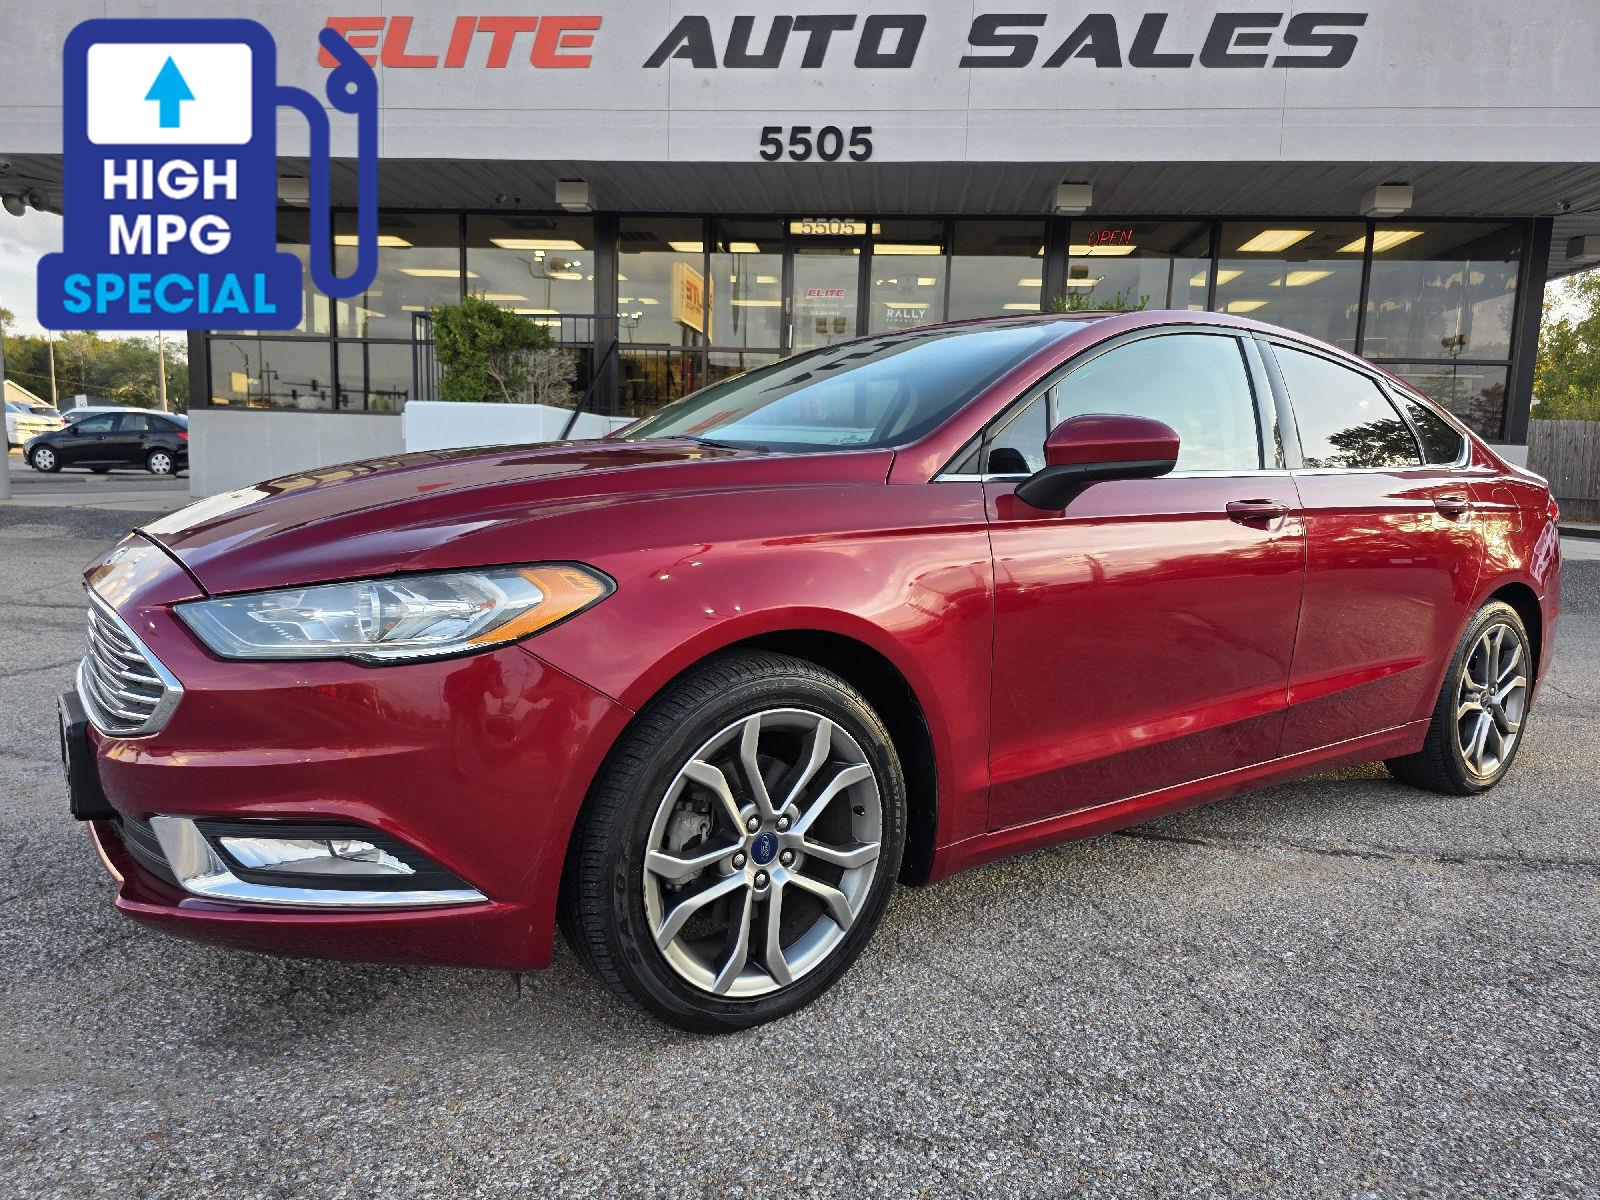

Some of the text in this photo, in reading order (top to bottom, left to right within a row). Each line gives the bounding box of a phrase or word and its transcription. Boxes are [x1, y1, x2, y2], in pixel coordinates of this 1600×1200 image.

[318, 12, 1369, 69] ELITE AUTO SALES
[759, 125, 873, 162] 5505
[801, 217, 856, 236] 5505
[1088, 229, 1134, 248] OPEN
[807, 288, 846, 297] ELITE
[886, 308, 927, 319] RALLY
